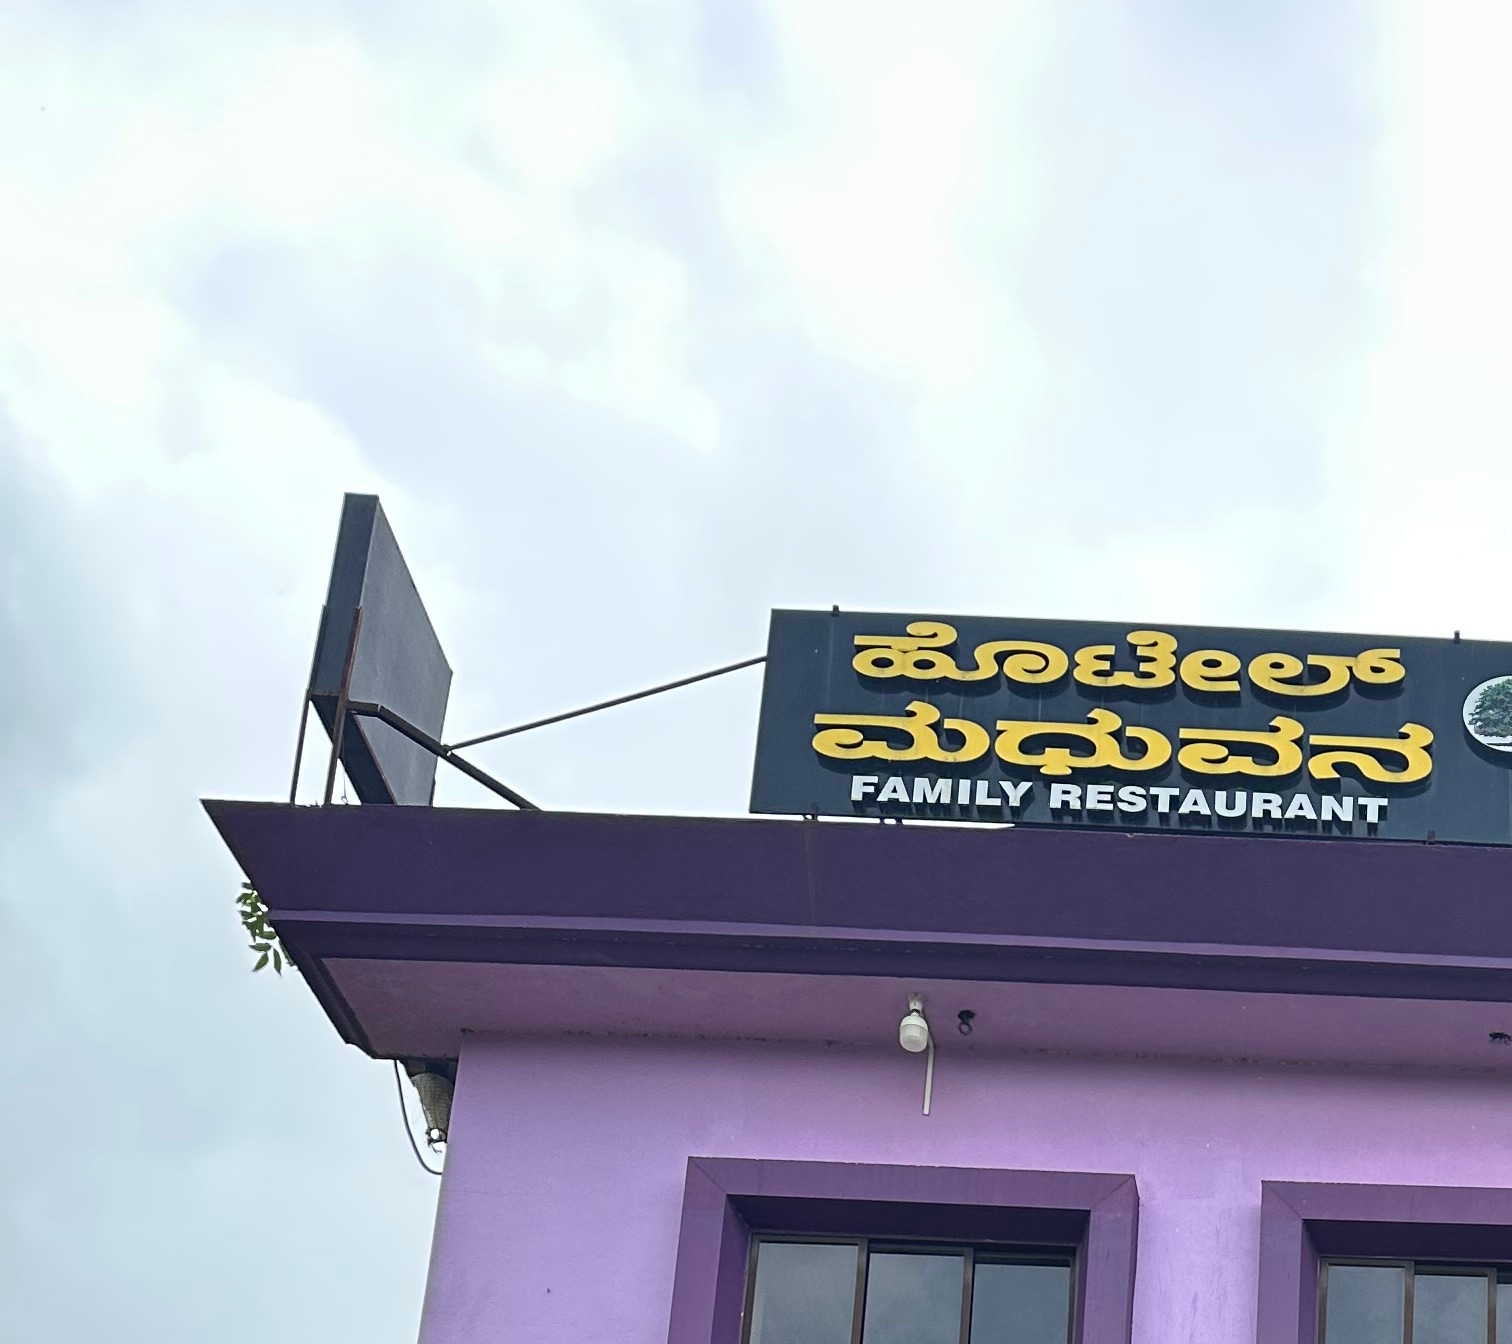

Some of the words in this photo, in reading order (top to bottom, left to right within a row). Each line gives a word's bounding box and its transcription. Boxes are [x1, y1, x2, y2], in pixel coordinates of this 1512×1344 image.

[812, 701, 1434, 785] ಮಧುವನ
[850, 775, 1033, 808] FAMILY
[1048, 781, 1388, 824] RESTAURANT
